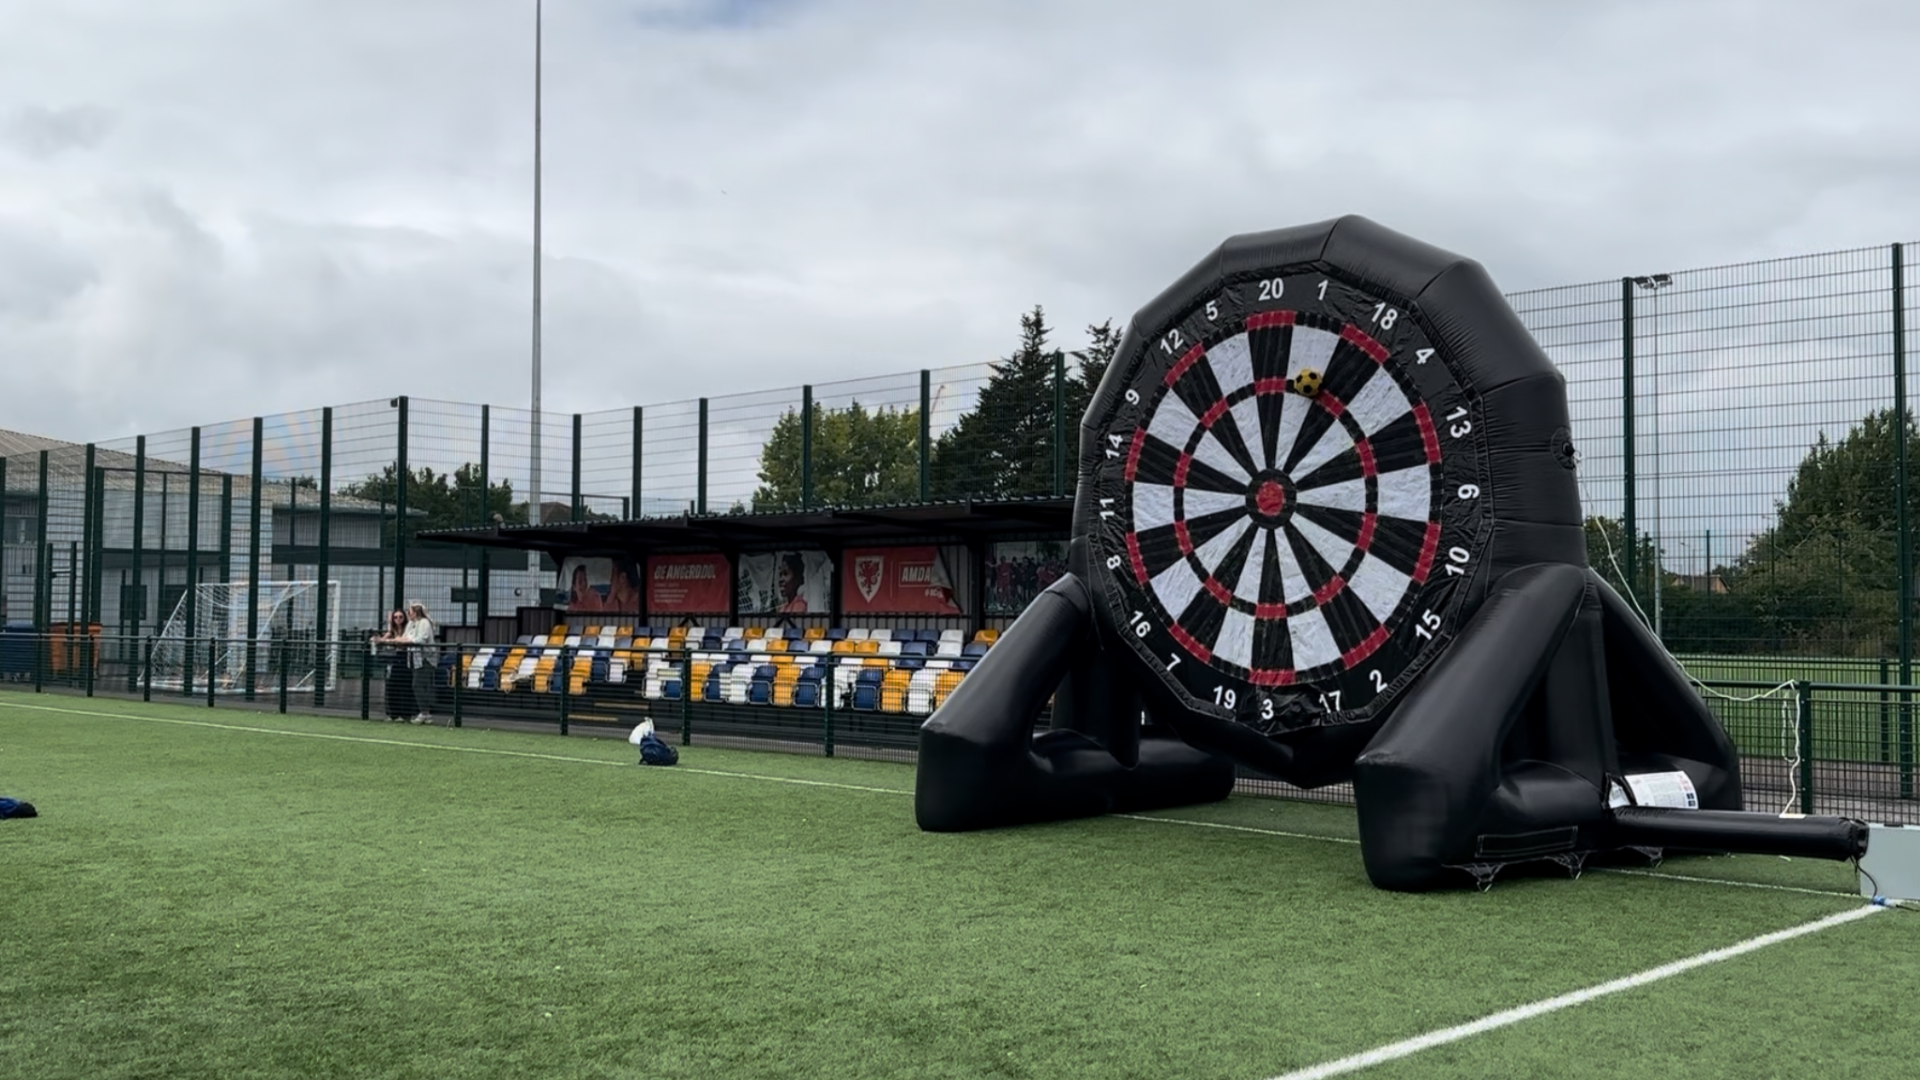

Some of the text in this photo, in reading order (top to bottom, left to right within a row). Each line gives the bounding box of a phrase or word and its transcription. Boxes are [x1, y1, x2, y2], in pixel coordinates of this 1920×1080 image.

[1258, 277, 1284, 301] 20
[1318, 279, 1329, 301] 1
[1205, 300, 1218, 321] 5
[1371, 302, 1398, 330] 18
[1160, 328, 1184, 355] 12
[1415, 347, 1435, 365] 4
[1125, 388, 1140, 406] 9
[1446, 406, 1472, 438] 13
[1105, 434, 1124, 459] 14
[1099, 498, 1115, 521] 11
[1106, 554, 1122, 570] 8
[1445, 546, 1470, 576] 10
[901, 566, 934, 582] AMDA
[1130, 610, 1151, 638] 16
[1415, 609, 1441, 640] 15
[1166, 653, 1181, 672] 7
[1369, 669, 1388, 693] 2
[1213, 685, 1236, 710] 19
[1261, 698, 1275, 720] 3
[1319, 690, 1341, 714] 17
